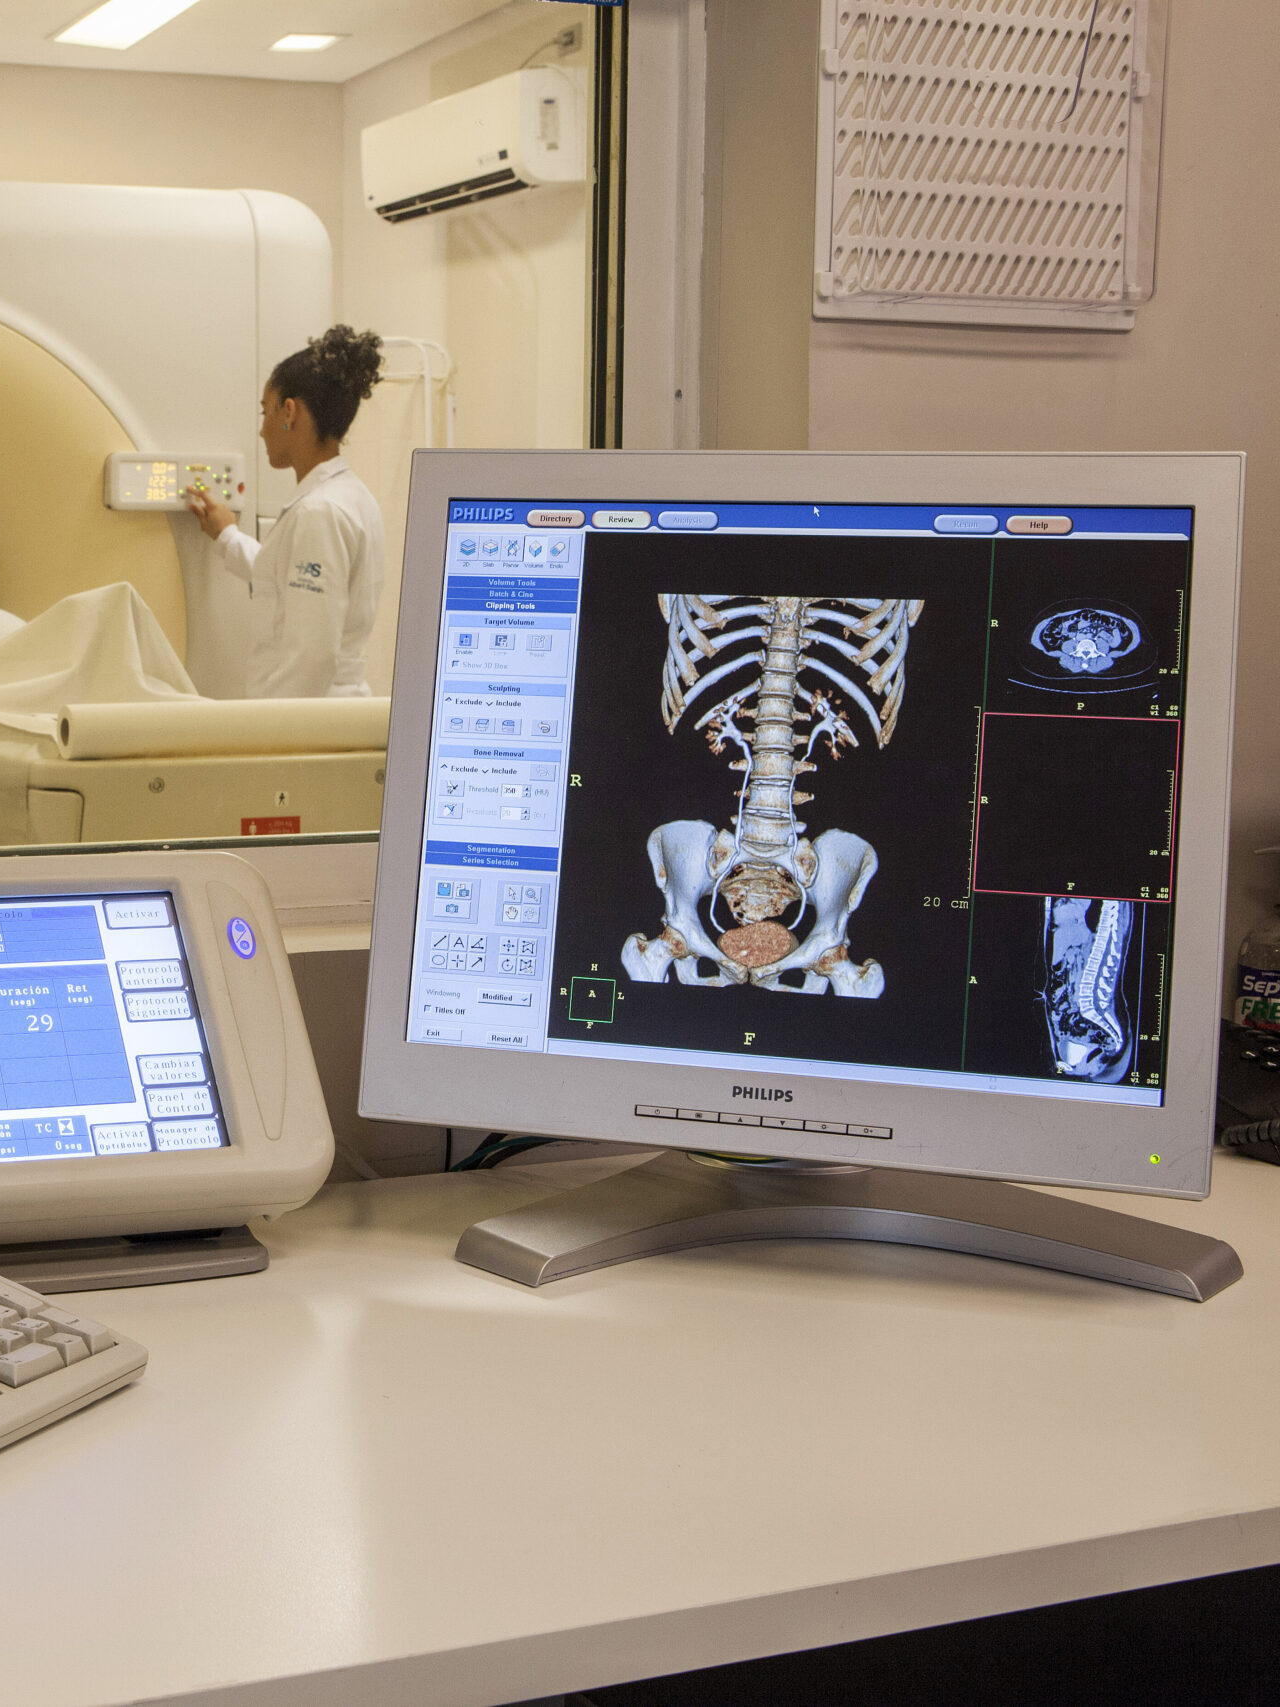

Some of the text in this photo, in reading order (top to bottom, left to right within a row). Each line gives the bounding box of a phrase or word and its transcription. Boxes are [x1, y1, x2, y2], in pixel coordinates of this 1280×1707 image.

[453, 507, 514, 521] PHILIPS
[540, 514, 572, 524] Directory
[608, 516, 634, 524] Review
[1030, 521, 1048, 530] Help
[488, 579, 536, 587] Volume Tools
[489, 590, 507, 598] Batch
[486, 602, 535, 610] Clipping Tools
[484, 618, 507, 627] Target
[488, 684, 520, 694] Sculpting
[494, 750, 524, 758] Removal
[570, 775, 582, 787] R
[980, 796, 988, 804] R
[467, 845, 515, 854] Segmentation
[487, 858, 519, 866] Selection
[924, 897, 969, 910] 20 cm
[115, 909, 160, 919] Activar
[120, 965, 180, 975] Protocolo
[126, 976, 177, 985] anterior
[969, 976, 977, 984] A
[67, 984, 87, 993] Ret
[1243, 975, 1280, 996] Sep
[427, 989, 460, 997] Windowing
[11, 998, 35, 1007] (seg)
[127, 996, 187, 1006] Protocolo
[130, 1006, 189, 1018] siguiente
[26, 1014, 53, 1032] 29
[744, 1032, 755, 1045] F
[145, 1059, 196, 1070] Cambiar
[150, 1071, 197, 1080] valores
[149, 1091, 208, 1102] Panel de
[732, 1086, 793, 1102] PHILIPS
[157, 1103, 205, 1113] Control
[35, 1123, 51, 1134] TC
[98, 1129, 144, 1140] Activar
[158, 1135, 219, 1147] Protocolo
[0, 1146, 15, 1155] psi
[65, 1143, 81, 1151] seg
